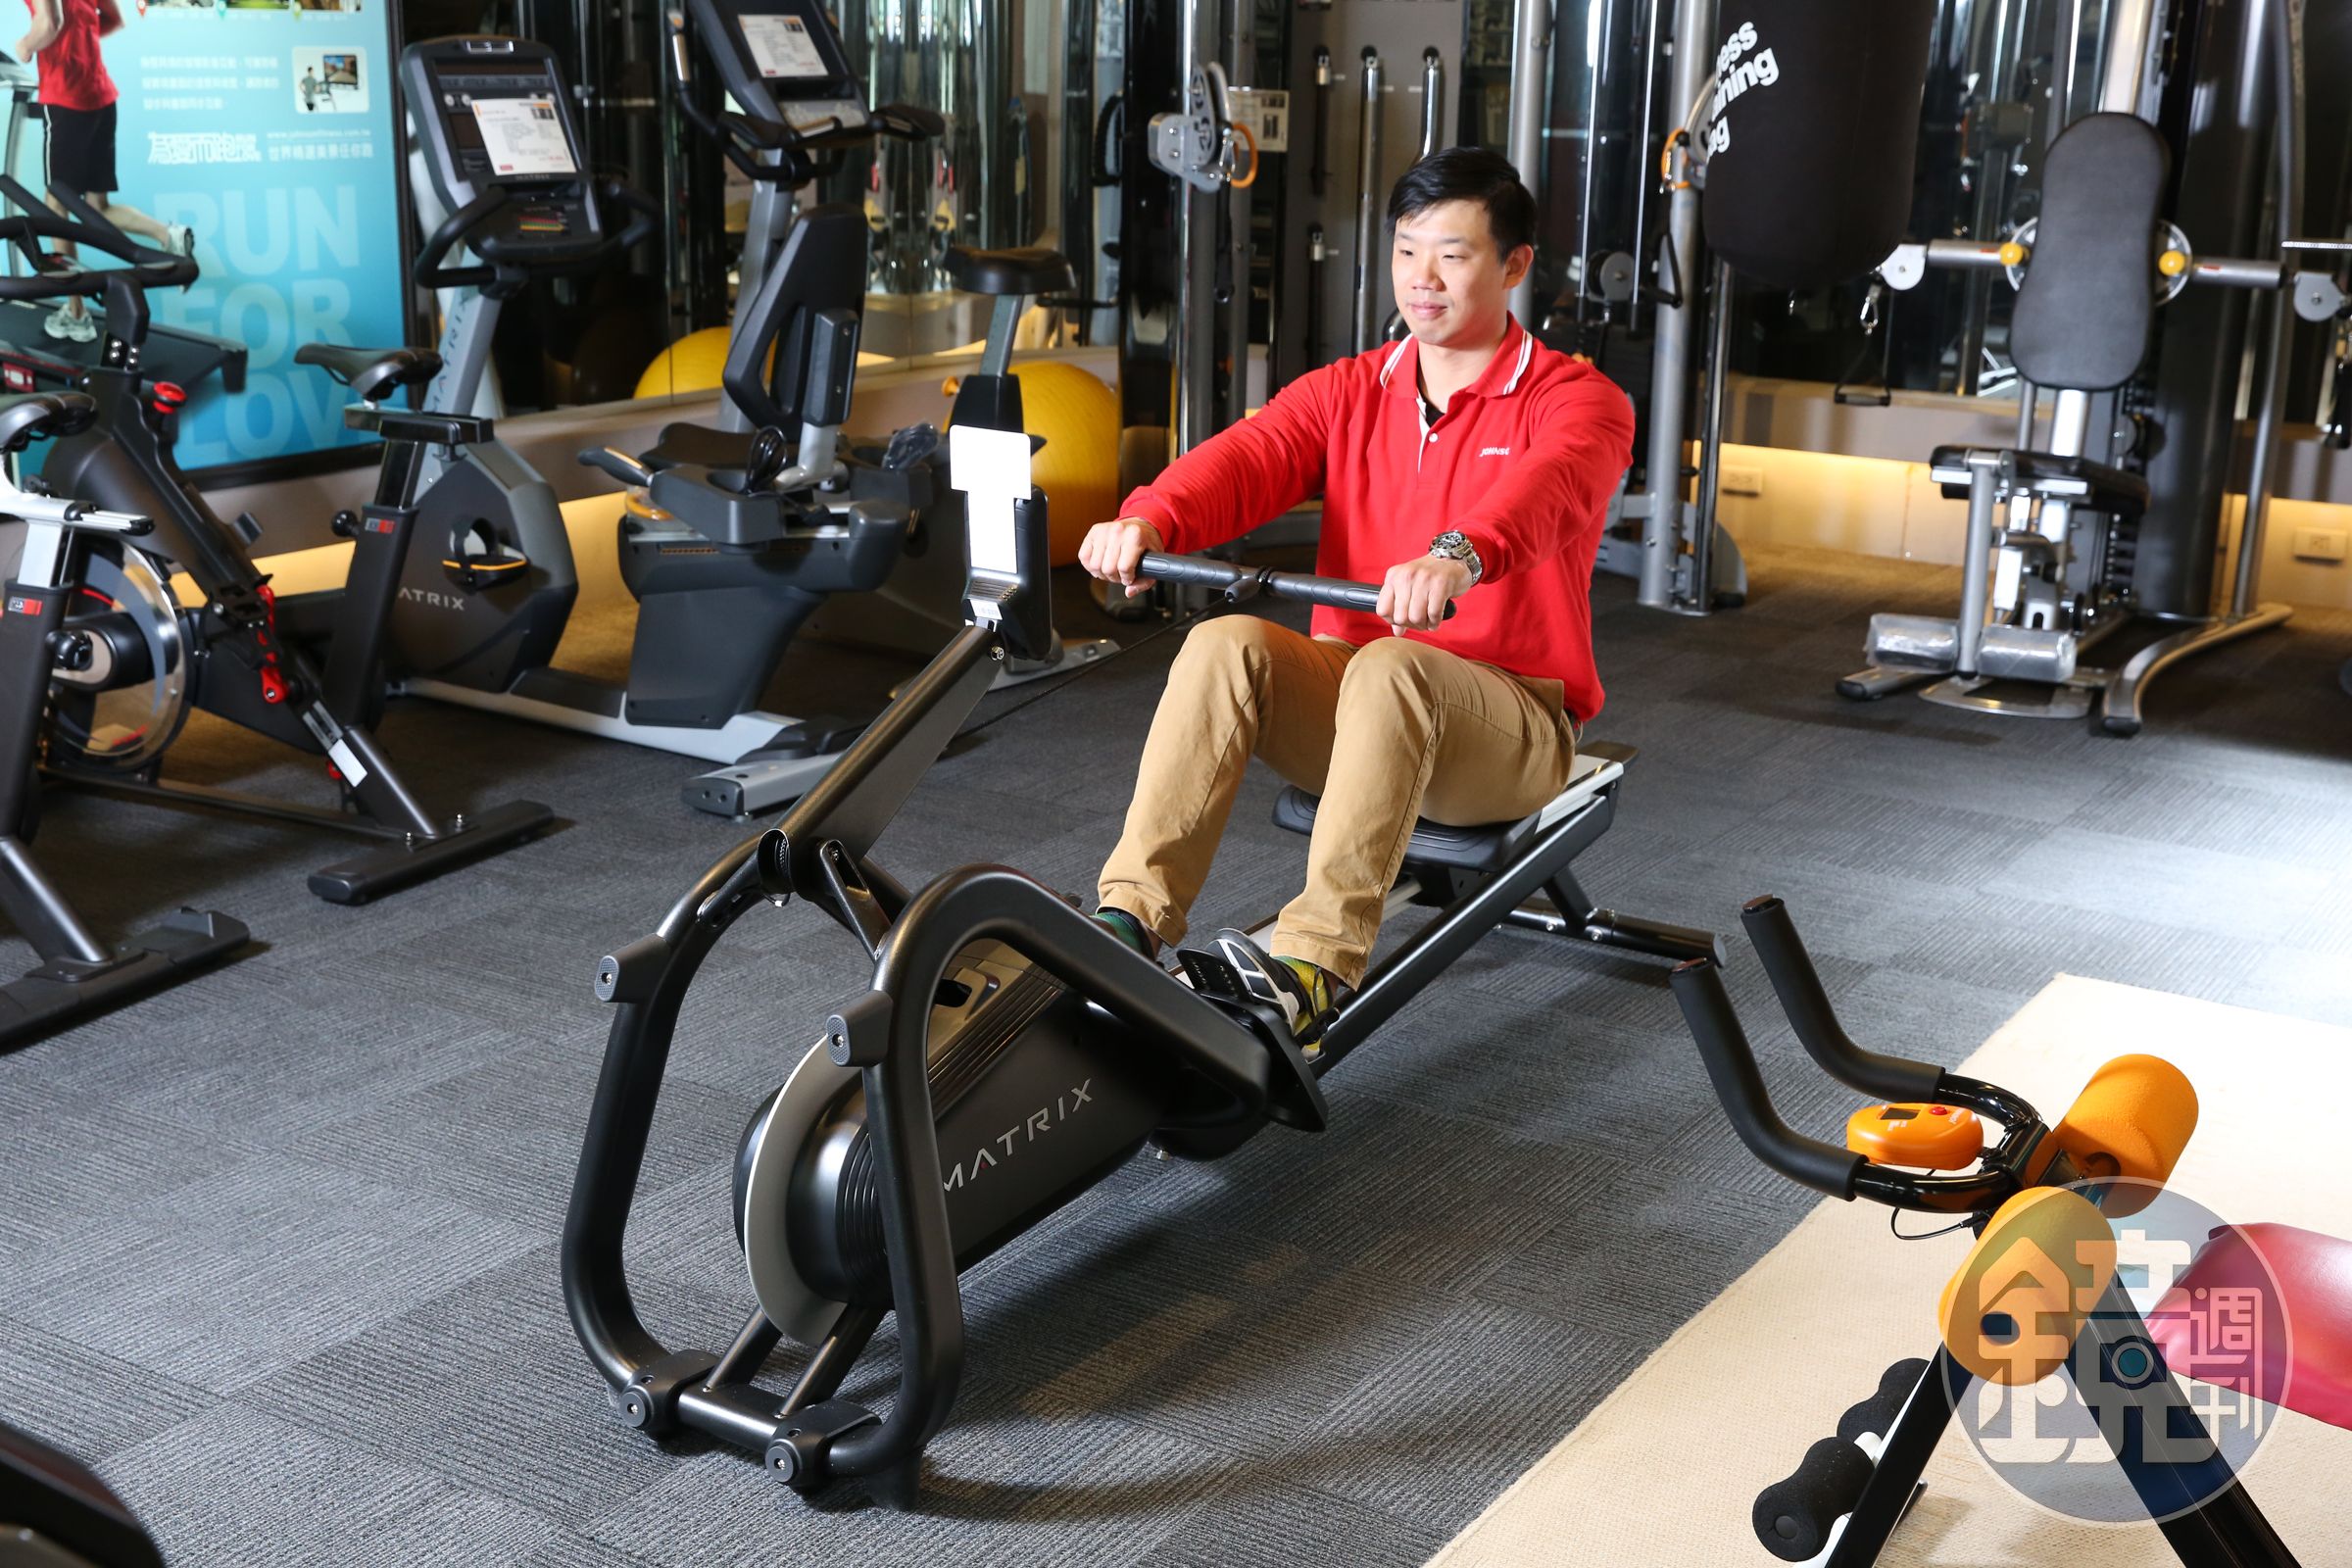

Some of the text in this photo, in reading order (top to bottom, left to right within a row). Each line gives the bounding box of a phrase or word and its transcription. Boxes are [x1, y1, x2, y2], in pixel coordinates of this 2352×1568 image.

[153, 184, 360, 277] RUN
[161, 278, 356, 370] FOR
[174, 369, 346, 466] LOV
[398, 587, 465, 612] ATRIX
